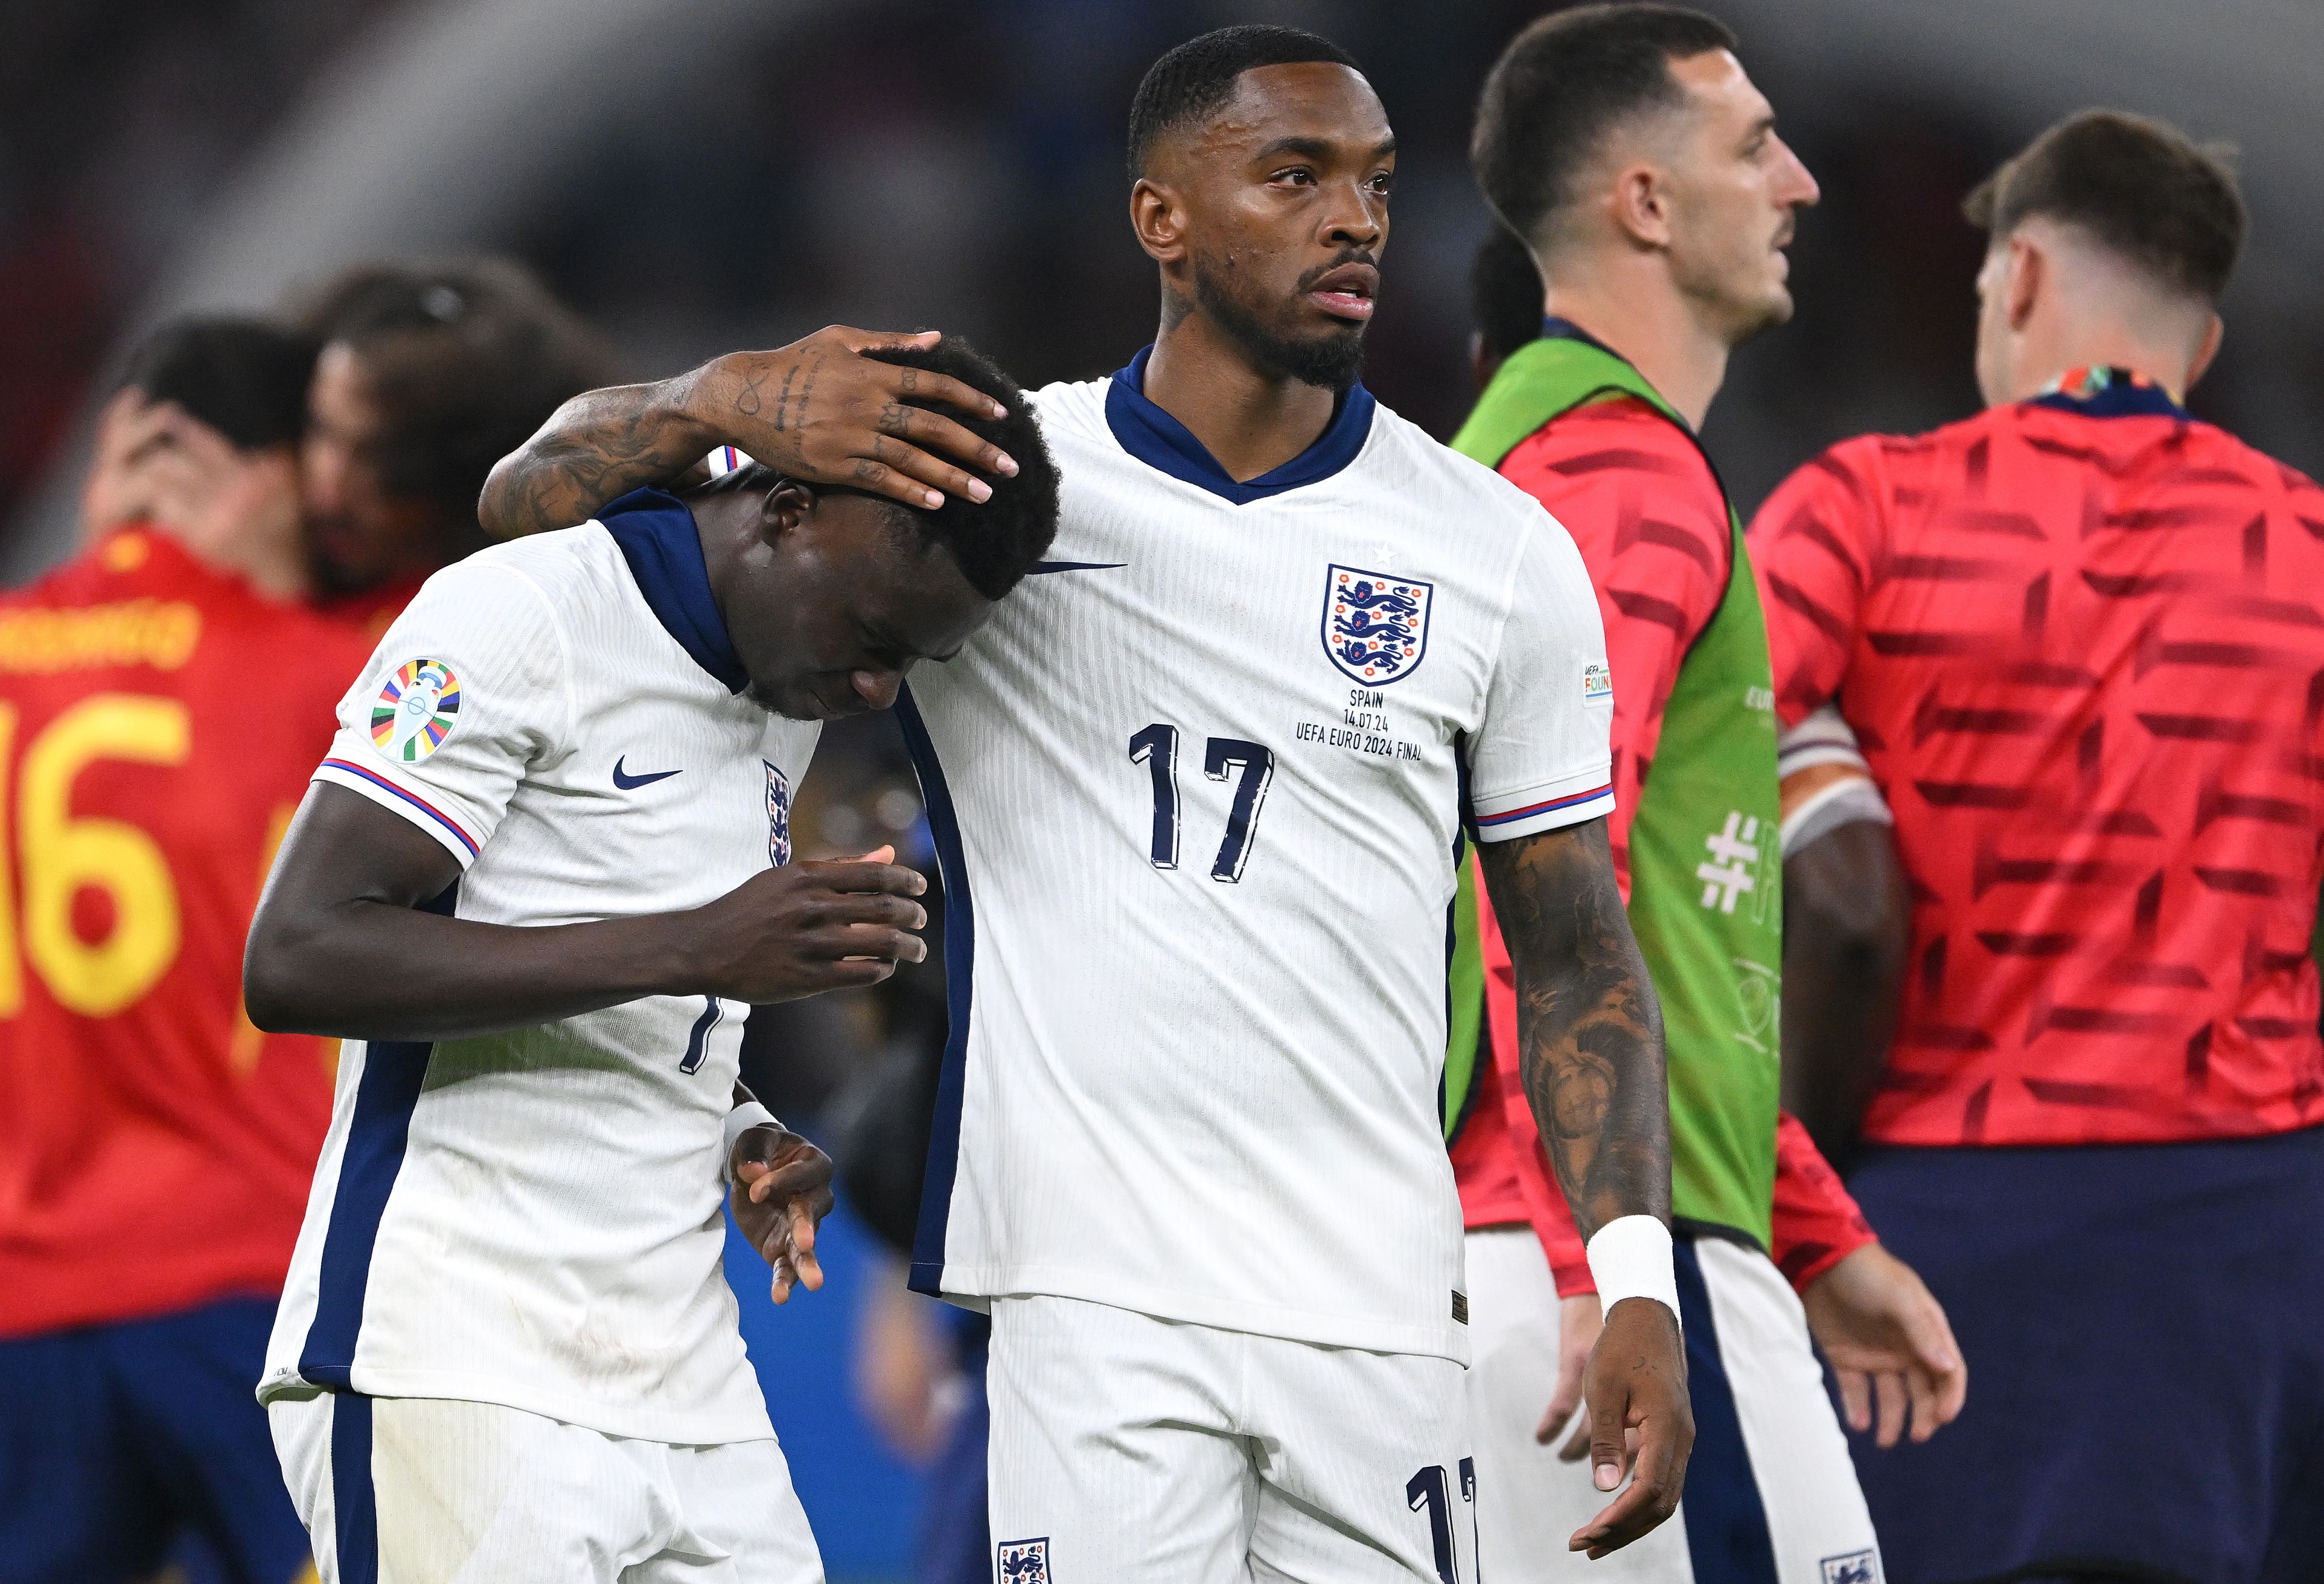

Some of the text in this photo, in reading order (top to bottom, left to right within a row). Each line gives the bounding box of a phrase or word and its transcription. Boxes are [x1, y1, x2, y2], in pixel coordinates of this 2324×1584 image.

[1585, 665, 1599, 675] UEFA
[1349, 689, 1384, 709] SPAIN
[1344, 708, 1388, 733] 14.07.24
[1296, 721, 1422, 761] UEFA EURO 2024 FINAL
[1129, 723, 1275, 884] 17
